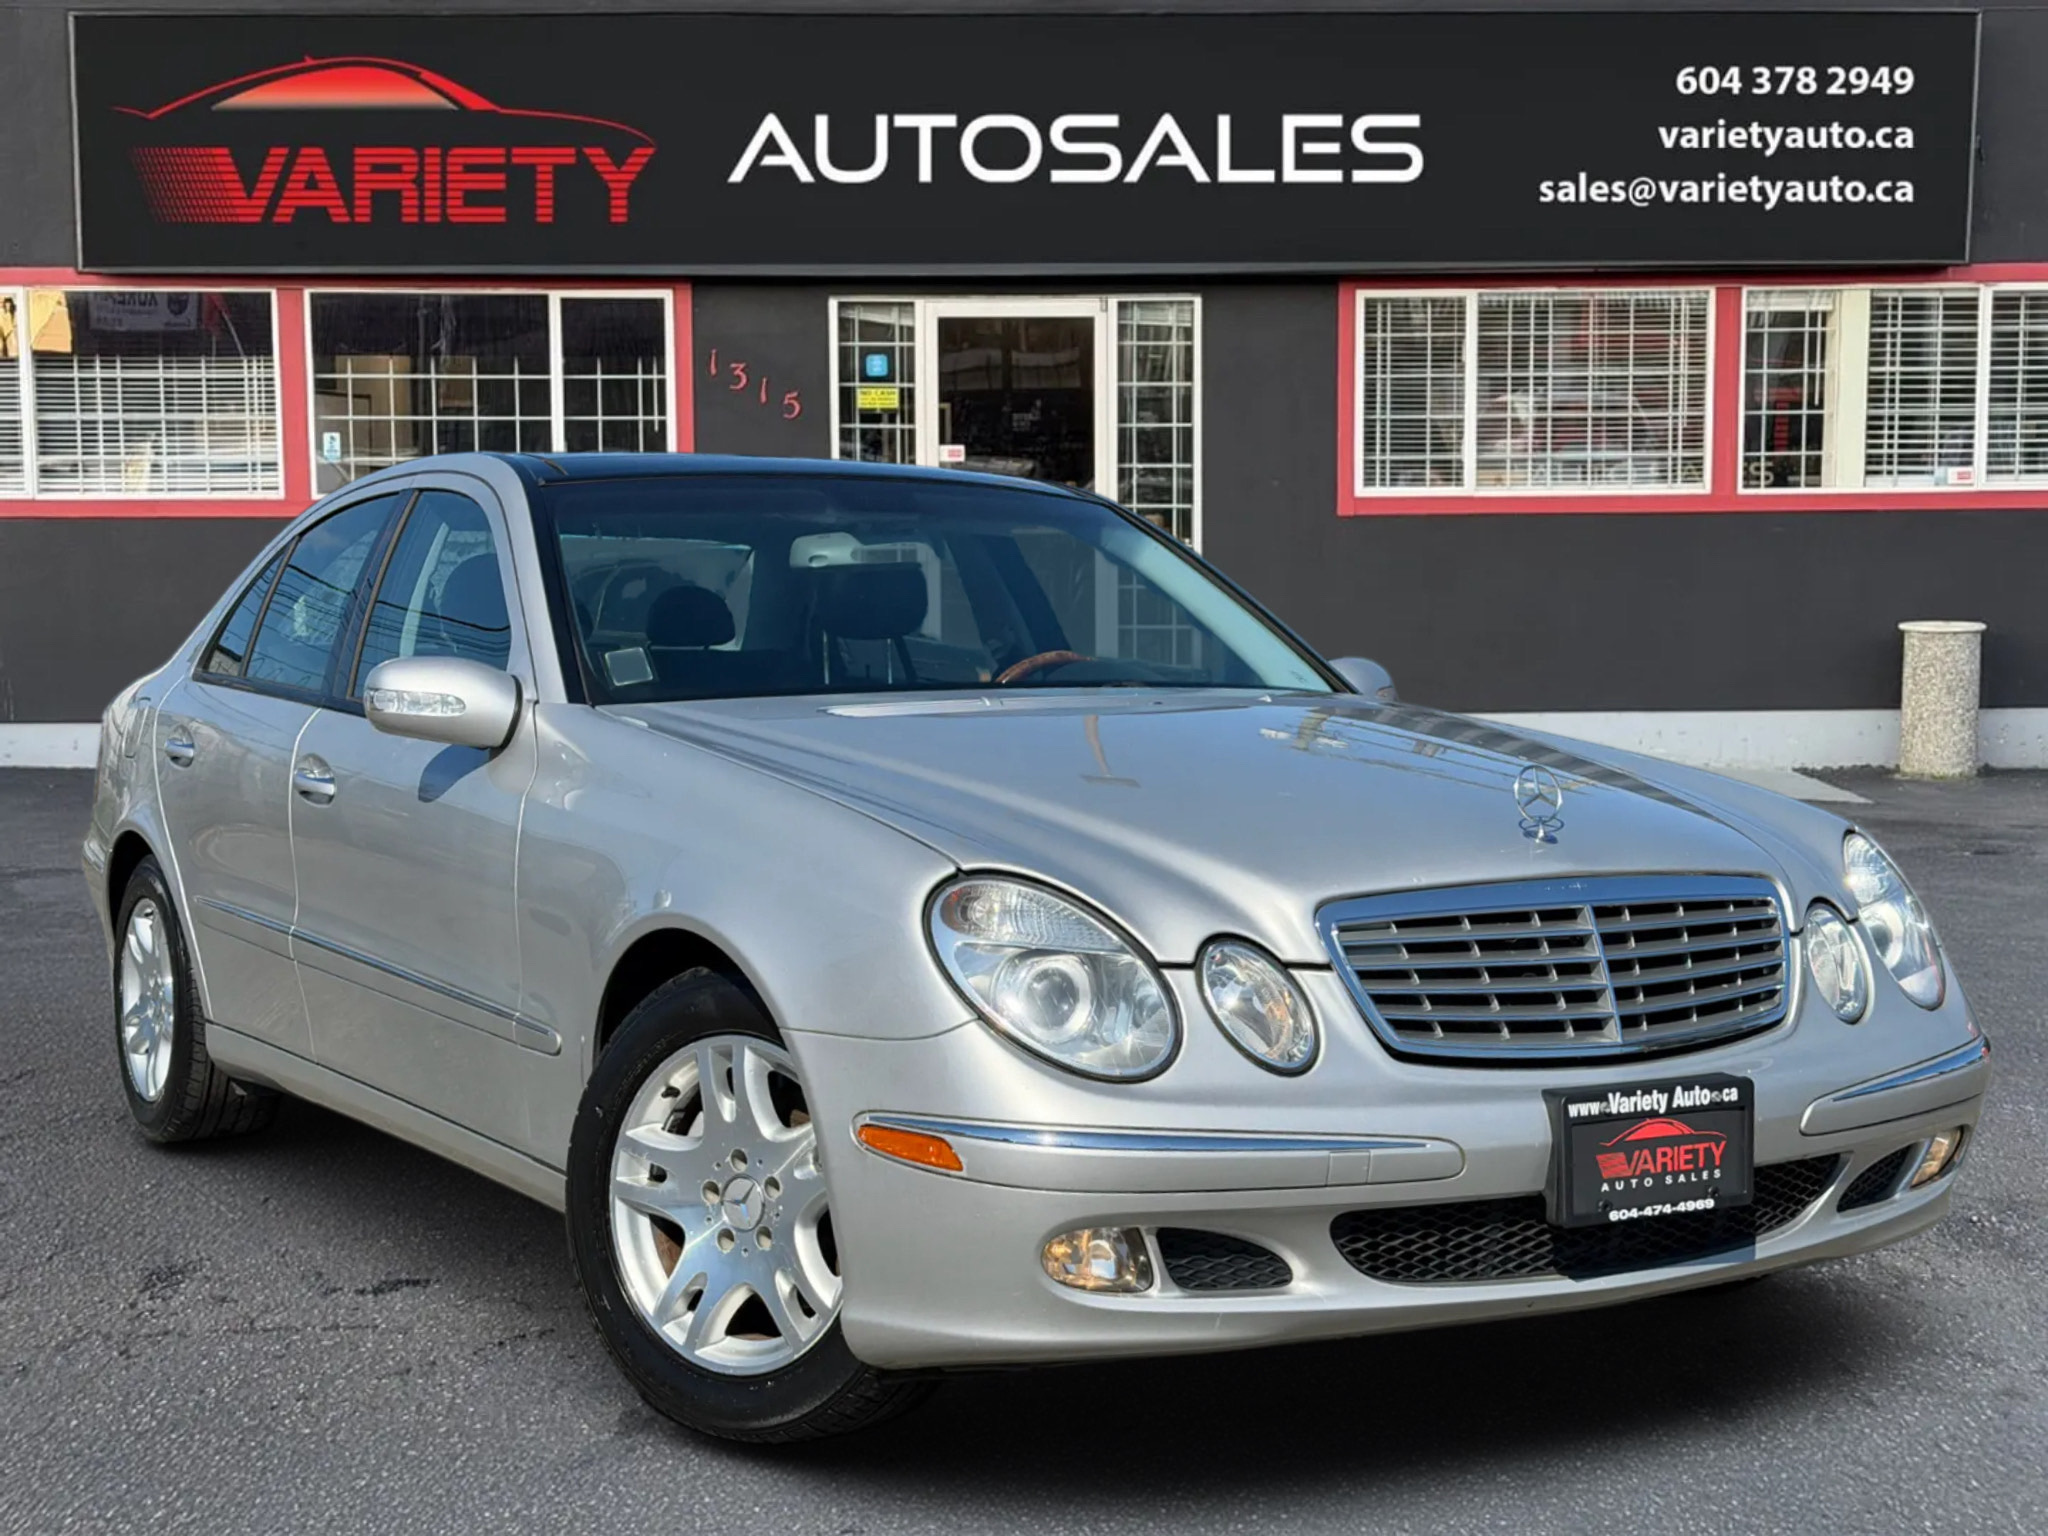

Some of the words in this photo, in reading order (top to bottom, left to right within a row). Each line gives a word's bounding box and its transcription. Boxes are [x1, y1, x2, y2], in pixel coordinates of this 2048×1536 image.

[1676, 65, 1743, 96] 604
[1751, 65, 1818, 96] 378
[1825, 65, 1915, 96] 2949
[727, 112, 1425, 184] AUTOSALES
[1658, 119, 1915, 158] varietyauto.ca
[138, 145, 656, 224] VARIETY
[1539, 171, 1915, 211] sales@varietyauto.ca
[709, 348, 802, 420] 1315
[1596, 1140, 1727, 1179] VARIETY
[1601, 1177, 1653, 1193] AUTO
[1665, 1168, 1721, 1185] SALES
[1608, 1198, 1715, 1222] 604-474-4969
